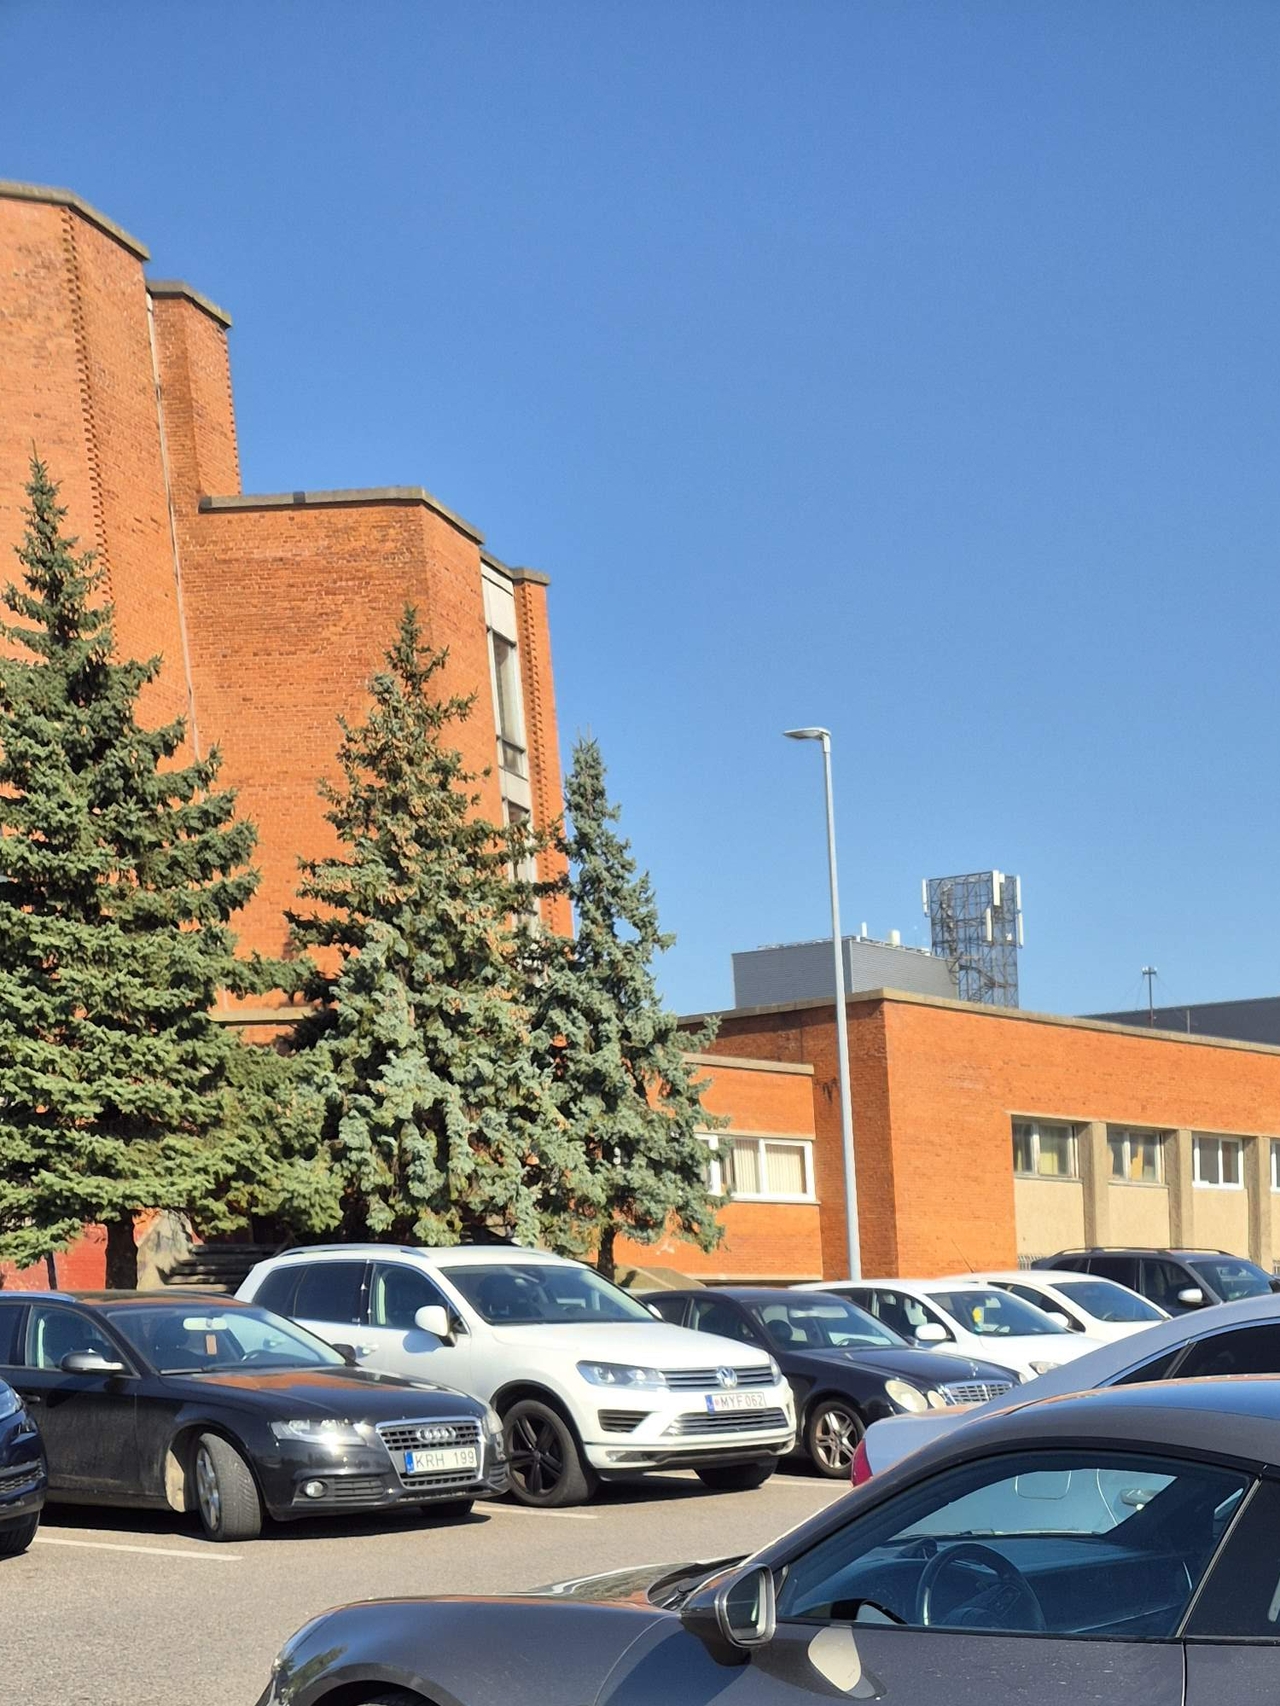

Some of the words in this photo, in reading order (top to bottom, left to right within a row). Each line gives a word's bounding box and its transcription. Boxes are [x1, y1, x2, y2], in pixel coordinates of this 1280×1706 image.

[720, 1394, 743, 1409] MYF
[744, 1394, 764, 1407] 062
[415, 1453, 445, 1468] KRH
[454, 1451, 475, 1465] 199
